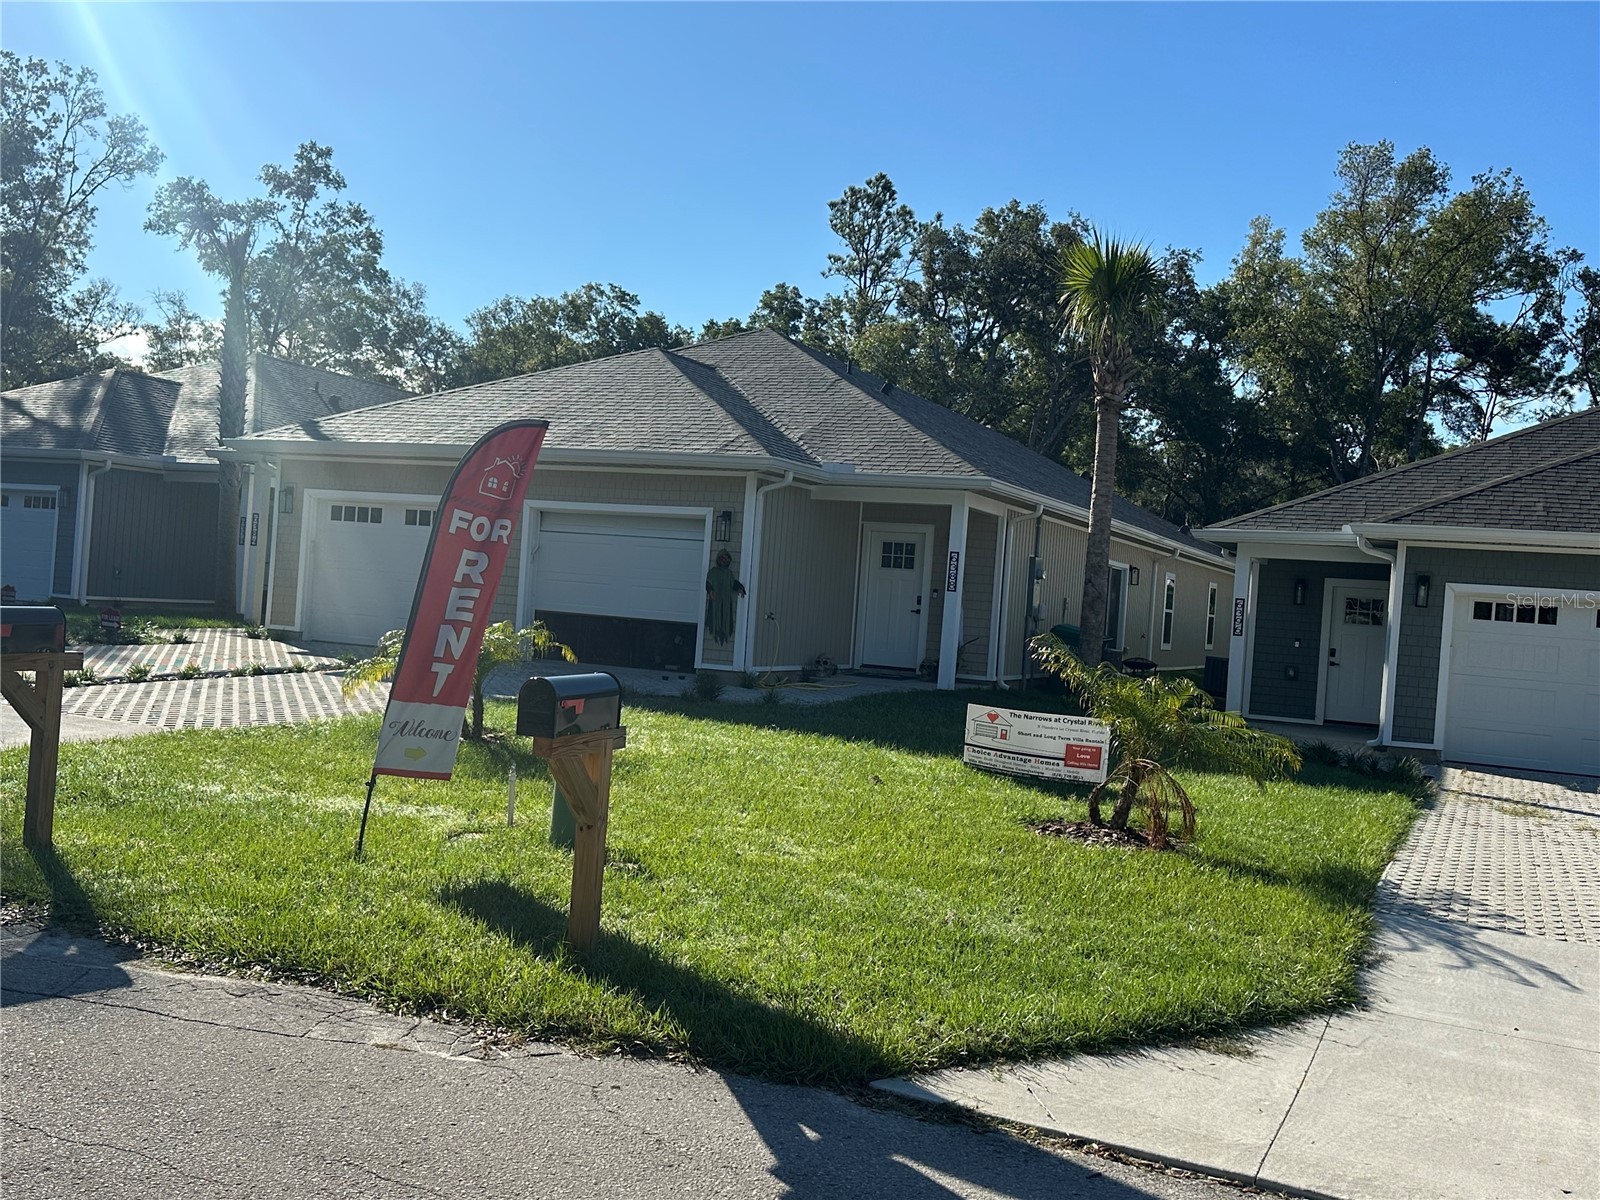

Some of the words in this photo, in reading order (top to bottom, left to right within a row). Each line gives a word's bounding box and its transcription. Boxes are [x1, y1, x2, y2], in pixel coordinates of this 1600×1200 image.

[449, 508, 512, 545] FOR
[430, 548, 490, 698] RENT
[1009, 711, 1022, 719] The
[1023, 713, 1053, 723] Narrows
[1054, 716, 1061, 724] at
[1062, 717, 1087, 726] Crystal
[388, 718, 458, 742] Welcome
[1044, 733, 1056, 741] Long
[966, 746, 992, 757] Choice
[993, 752, 1032, 764] Advantage
[1034, 758, 1060, 767] Homes
[1076, 752, 1091, 760] Love
